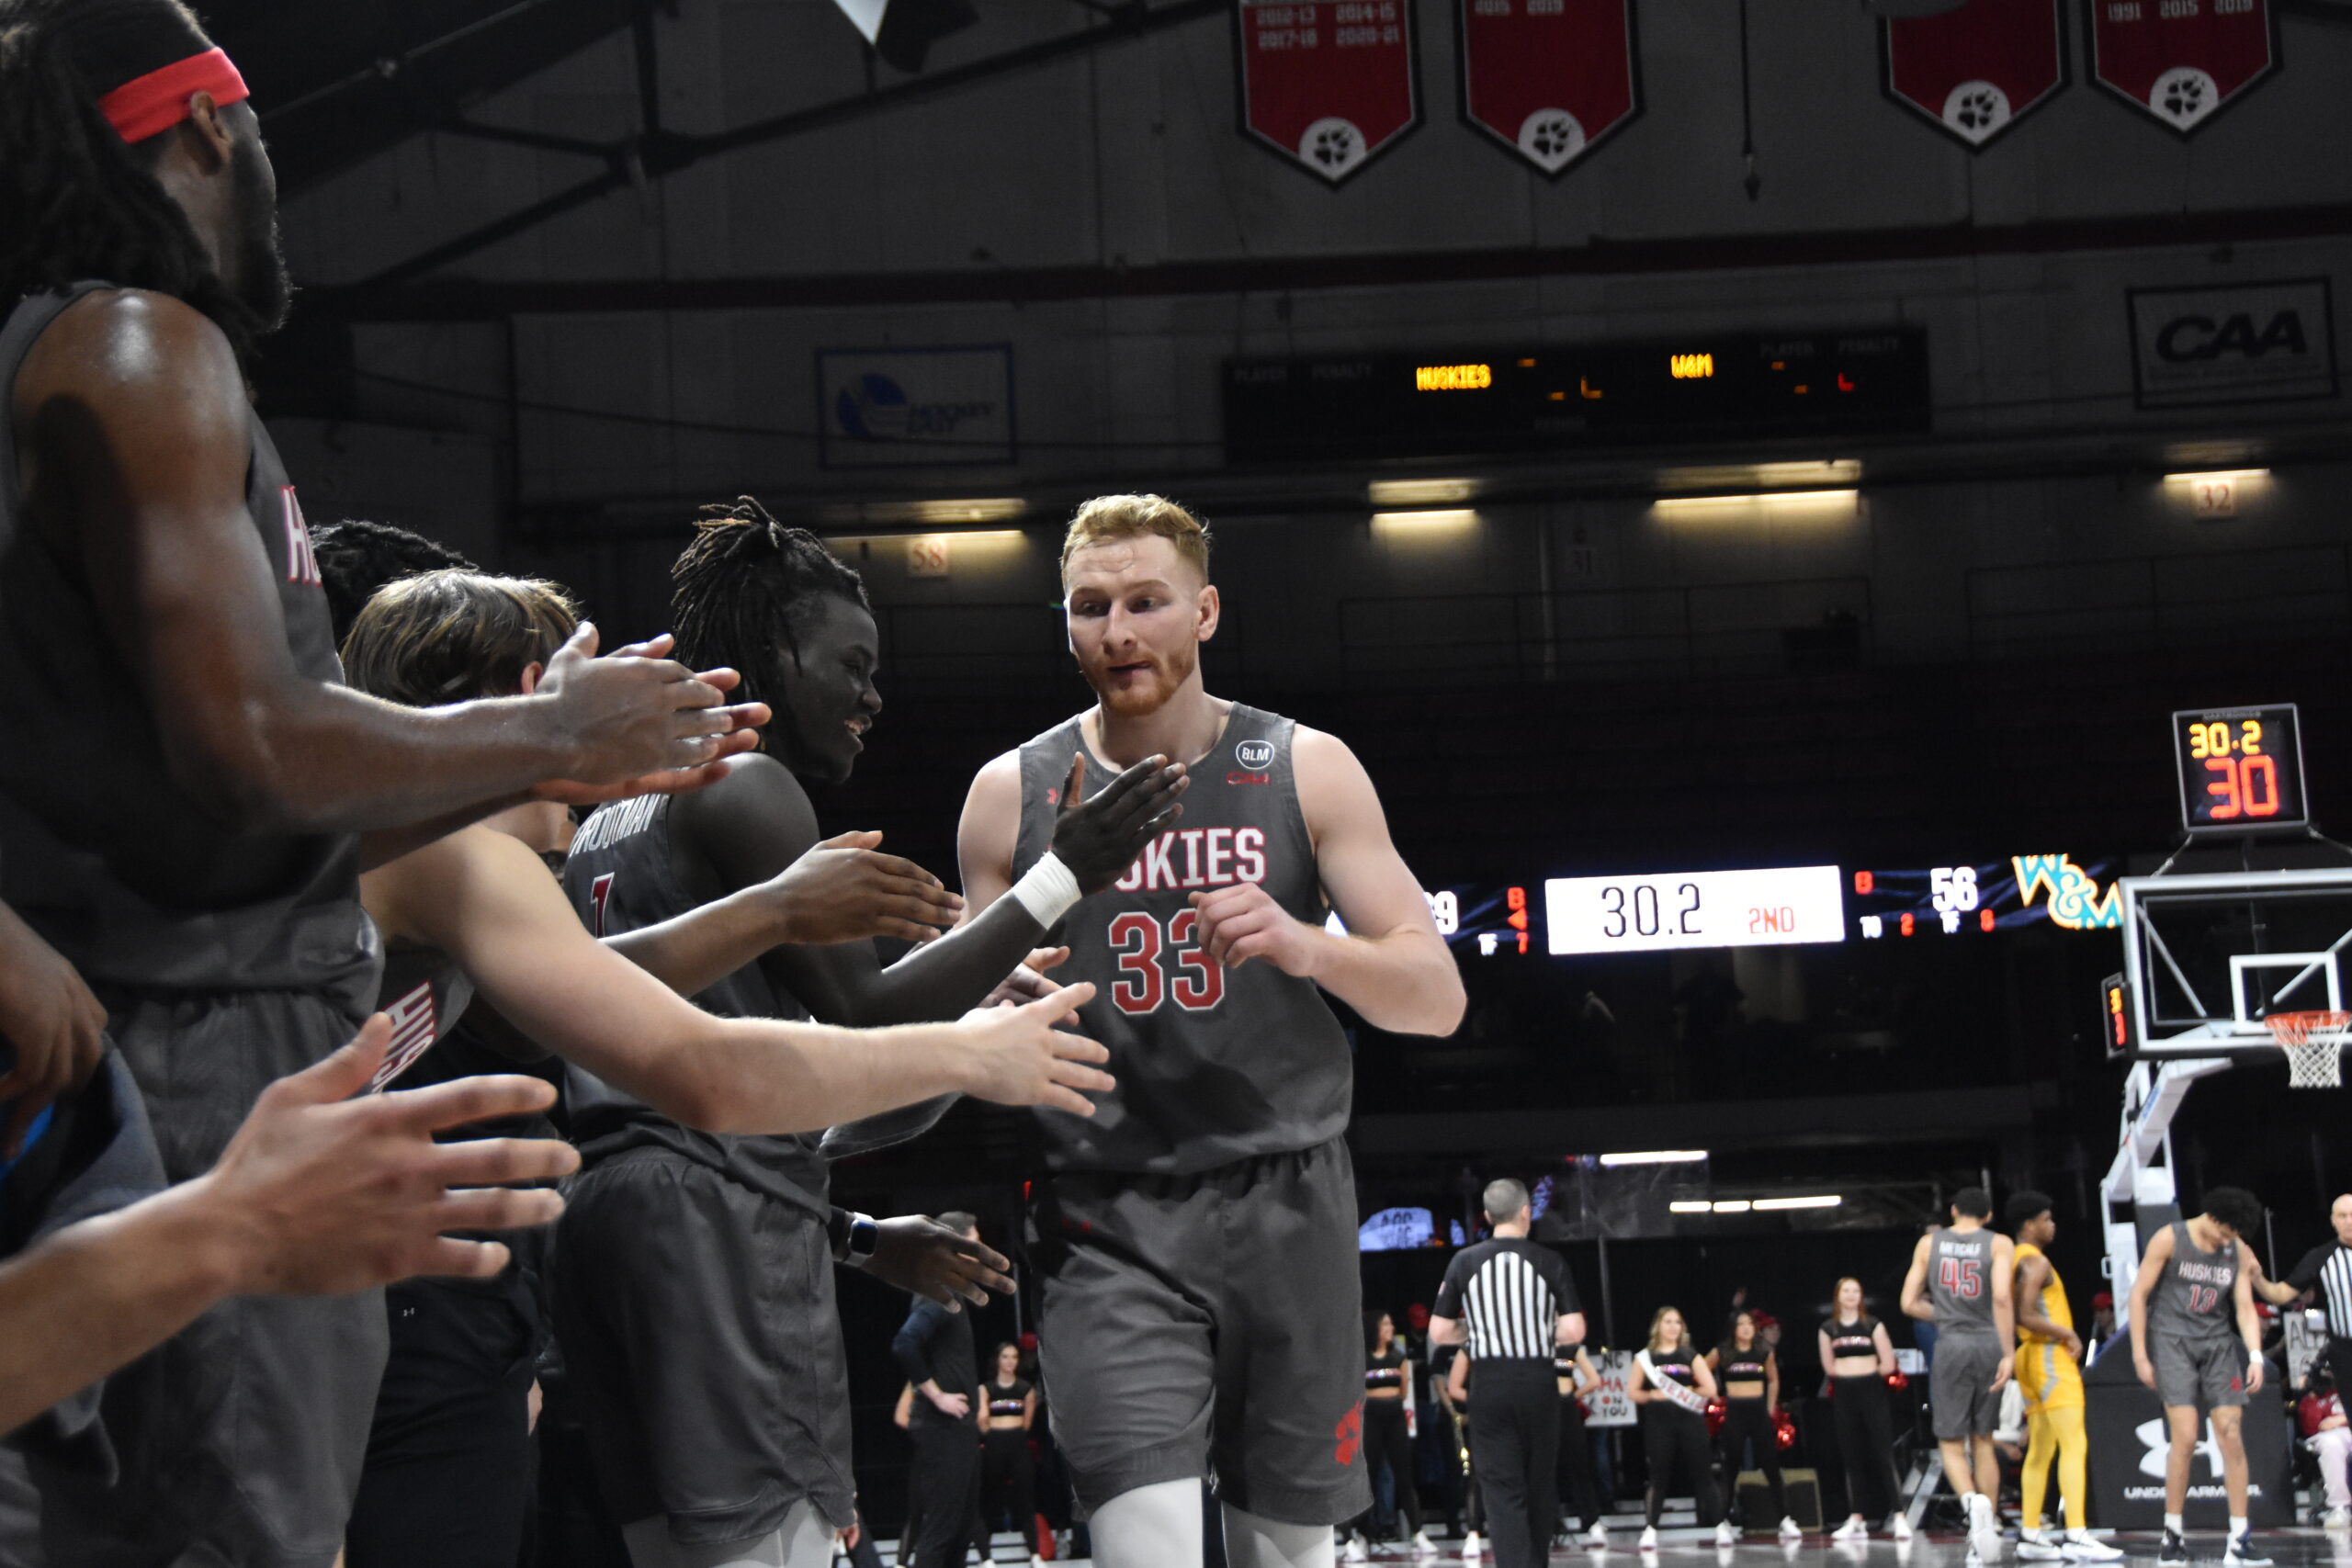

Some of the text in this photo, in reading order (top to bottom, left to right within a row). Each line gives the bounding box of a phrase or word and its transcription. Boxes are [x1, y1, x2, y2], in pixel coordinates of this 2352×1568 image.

[2156, 310, 2308, 363] CAA
[1416, 364, 1492, 391] HUSKIES
[1241, 746, 1271, 761] BLM
[2188, 720, 2262, 759] 30.2
[2205, 755, 2278, 818] 30
[1601, 883, 1795, 937] 30.2 2ND
[1929, 866, 1979, 911] 56
[2011, 852, 2124, 931] W&M
[1423, 890, 1459, 935] 9
[1108, 908, 1226, 1015] 33
[1939, 1258, 1983, 1299] 45
[2177, 1260, 2233, 1286] HUSKIES
